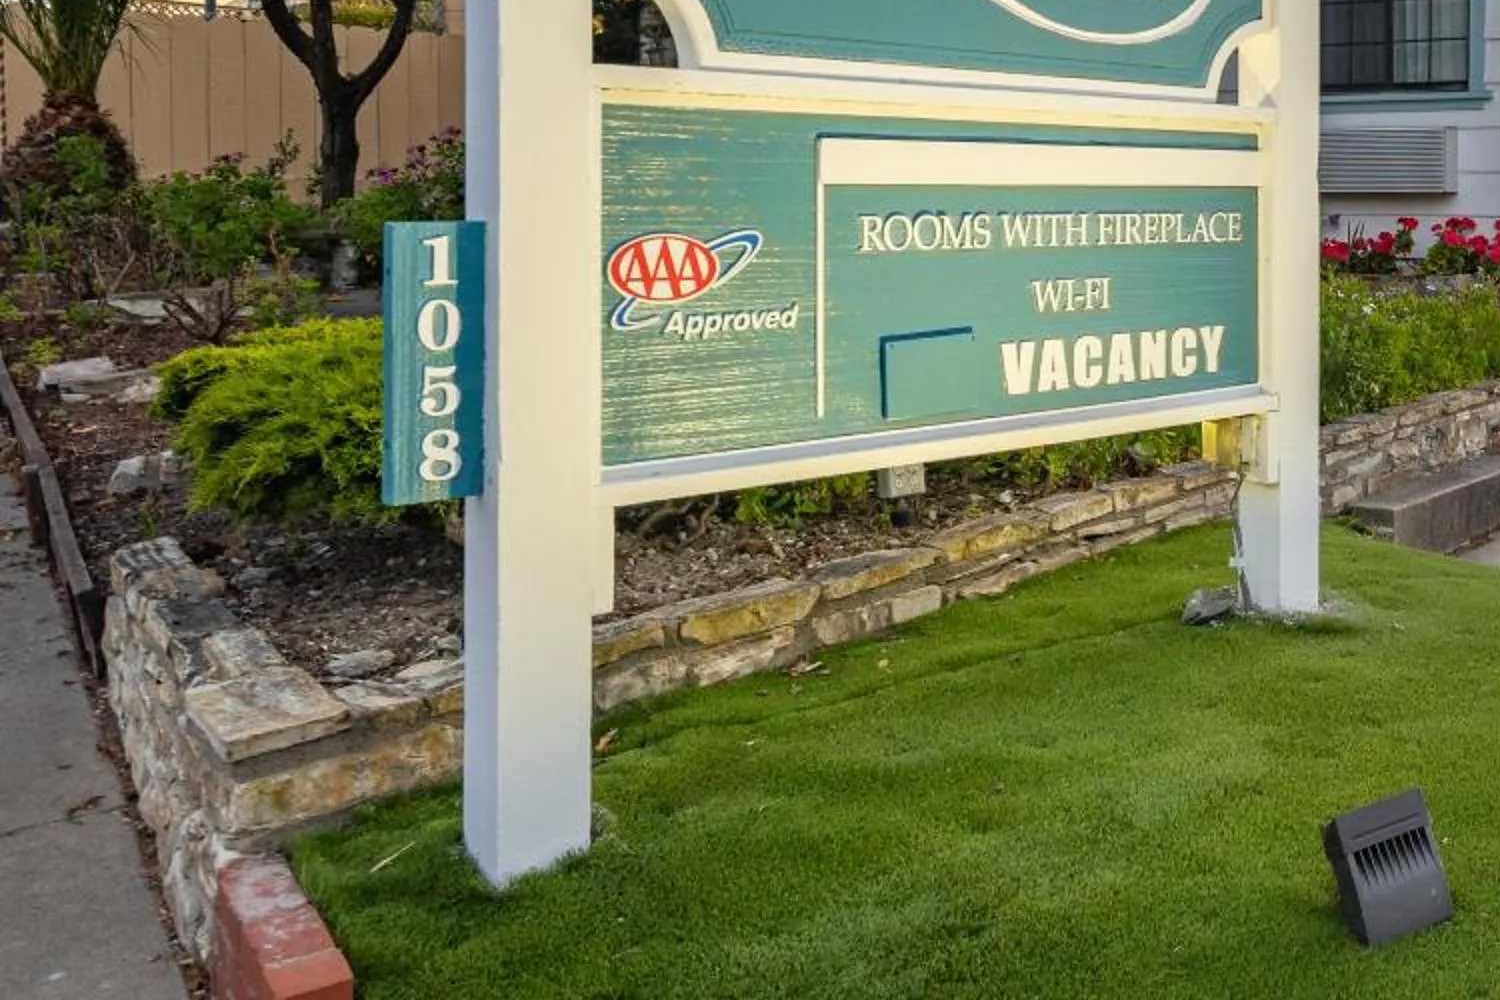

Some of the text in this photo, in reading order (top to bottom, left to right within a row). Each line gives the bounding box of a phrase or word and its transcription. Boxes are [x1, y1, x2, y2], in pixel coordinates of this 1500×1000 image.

[860, 212, 1243, 252] ROOMS WITH FIREPLACE
[625, 237, 707, 301] AAA
[1033, 277, 1112, 313] WI-FI
[663, 302, 799, 341] Approved
[417, 235, 462, 482] 1058
[1001, 325, 1225, 396] VACANCY
